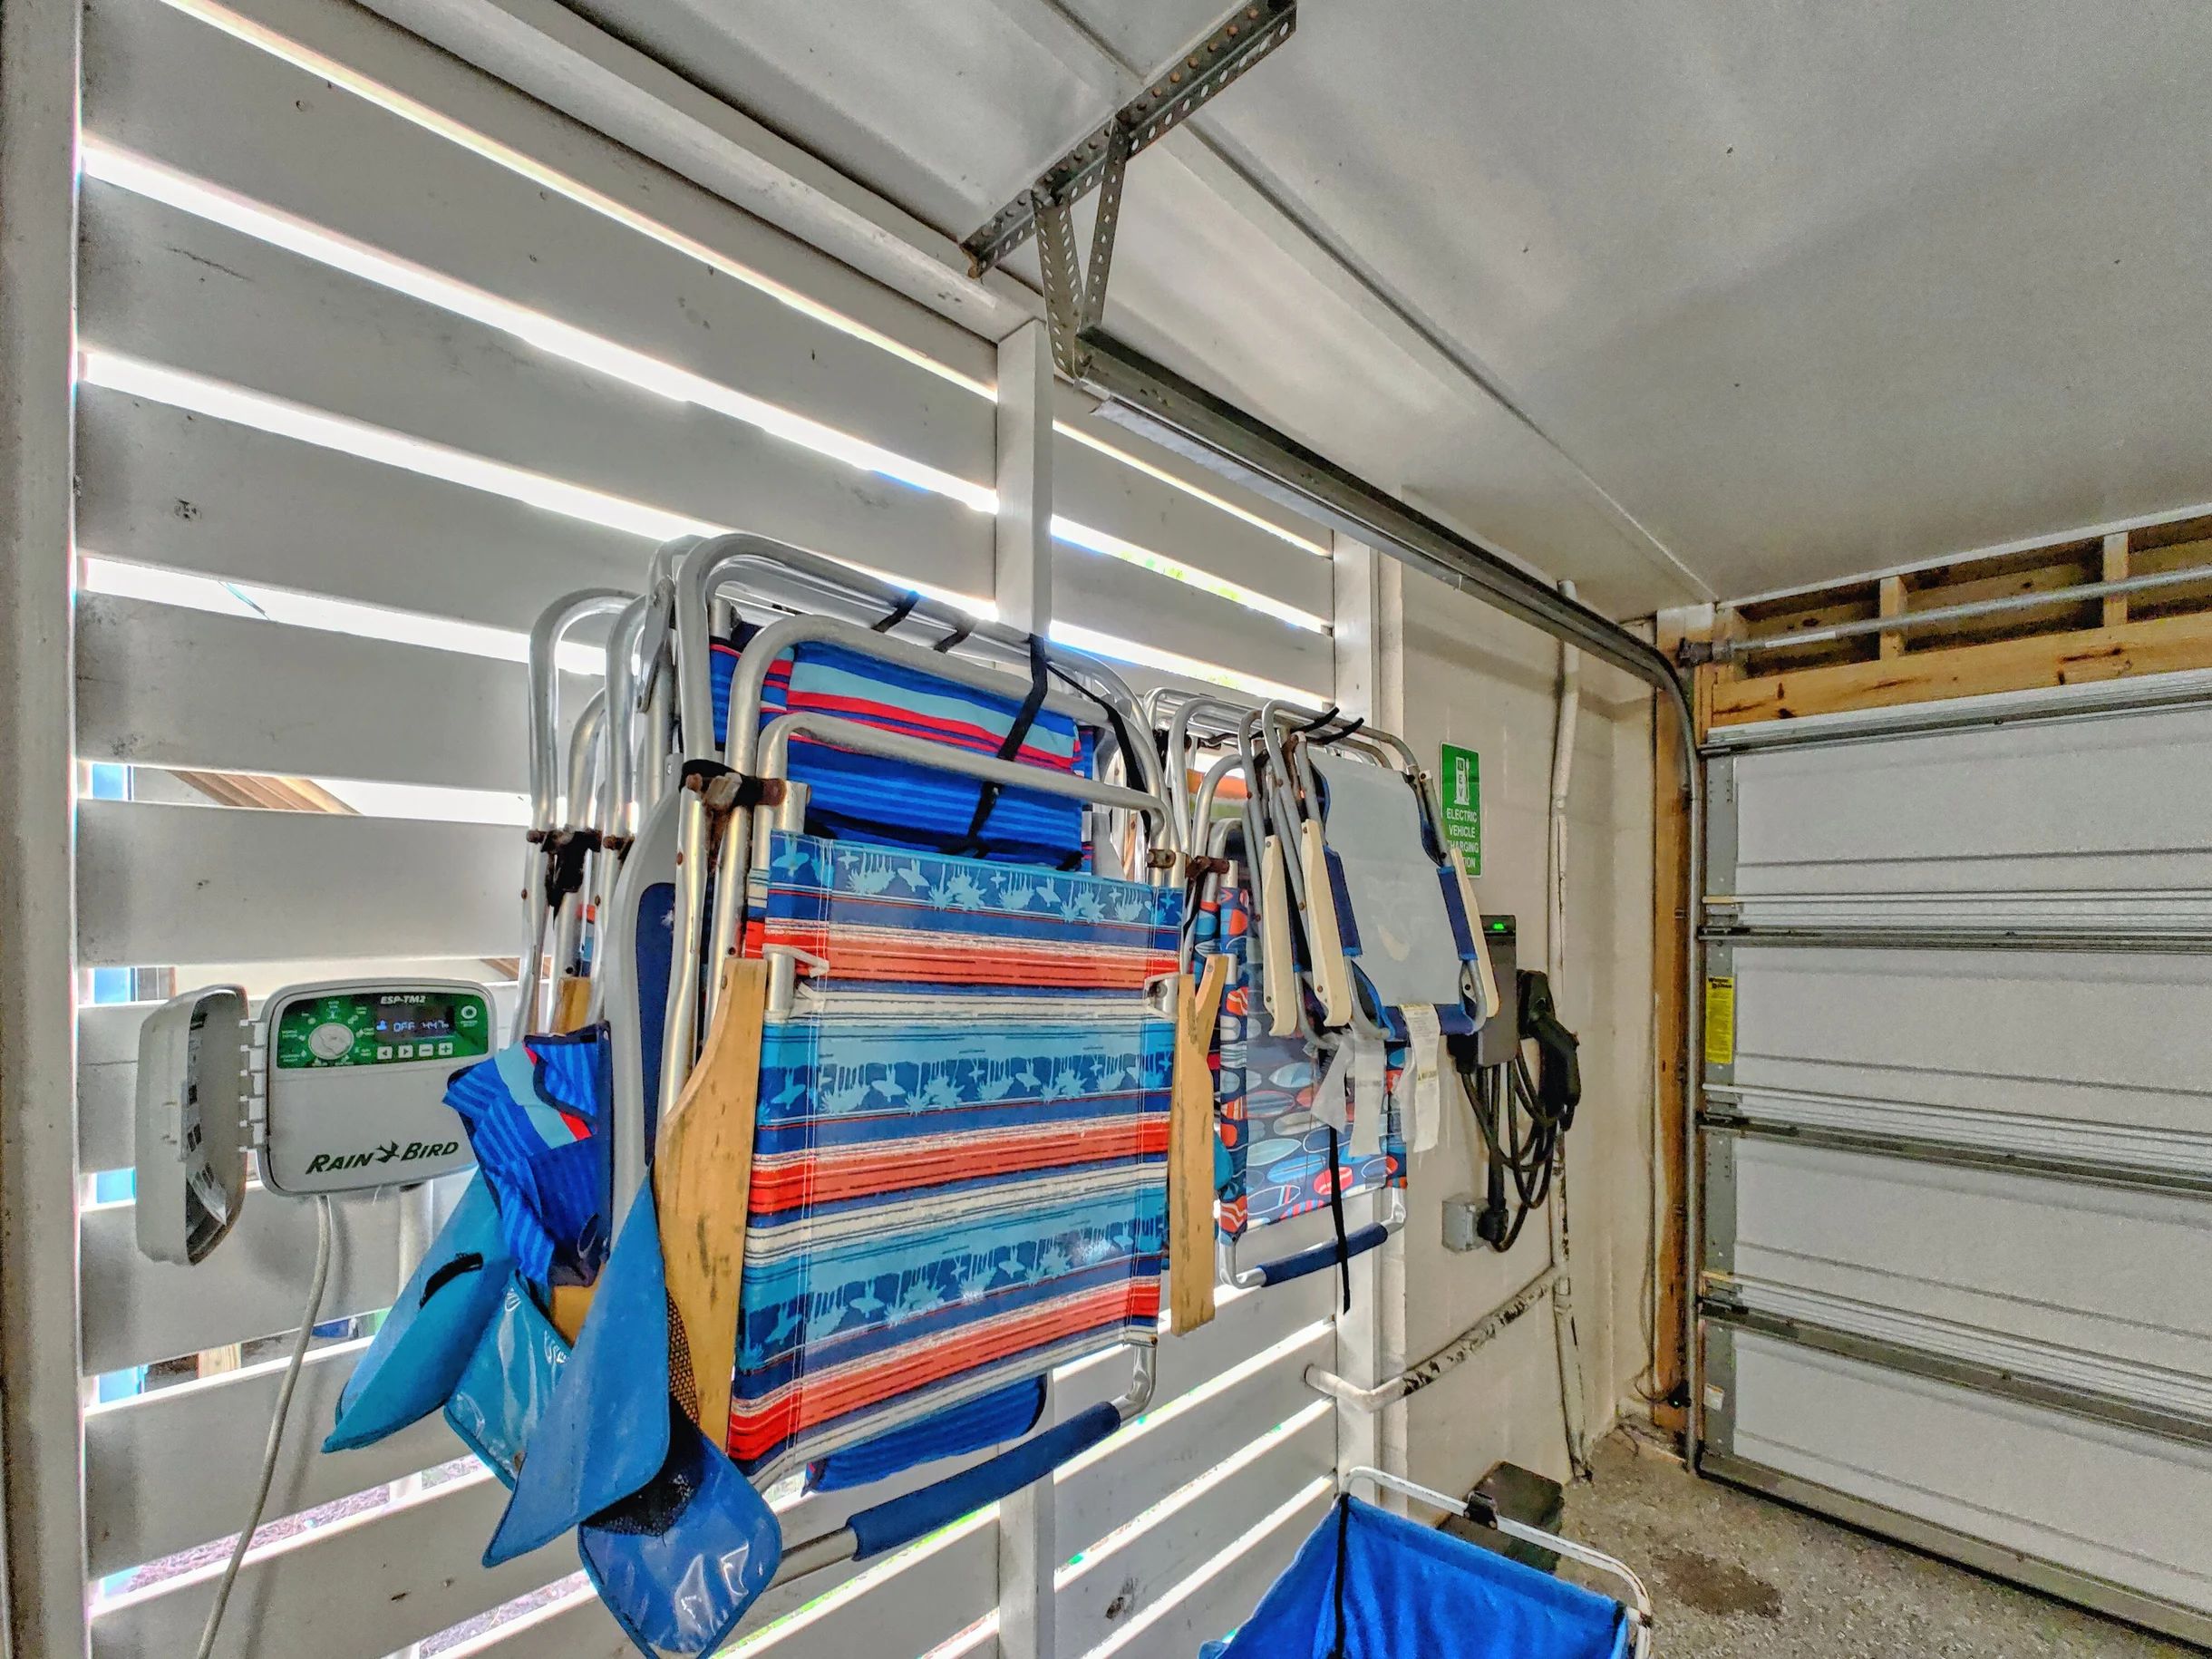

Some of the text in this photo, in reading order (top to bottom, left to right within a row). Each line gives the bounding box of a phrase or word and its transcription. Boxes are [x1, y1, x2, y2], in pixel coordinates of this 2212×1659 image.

[1446, 807, 1478, 823] ELECTRIC
[1448, 824, 1476, 839] VEHICLE
[380, 995, 426, 1004] ESP-TM2
[393, 1021, 415, 1033] OFF
[306, 1141, 459, 1175] RAIN BIRD
